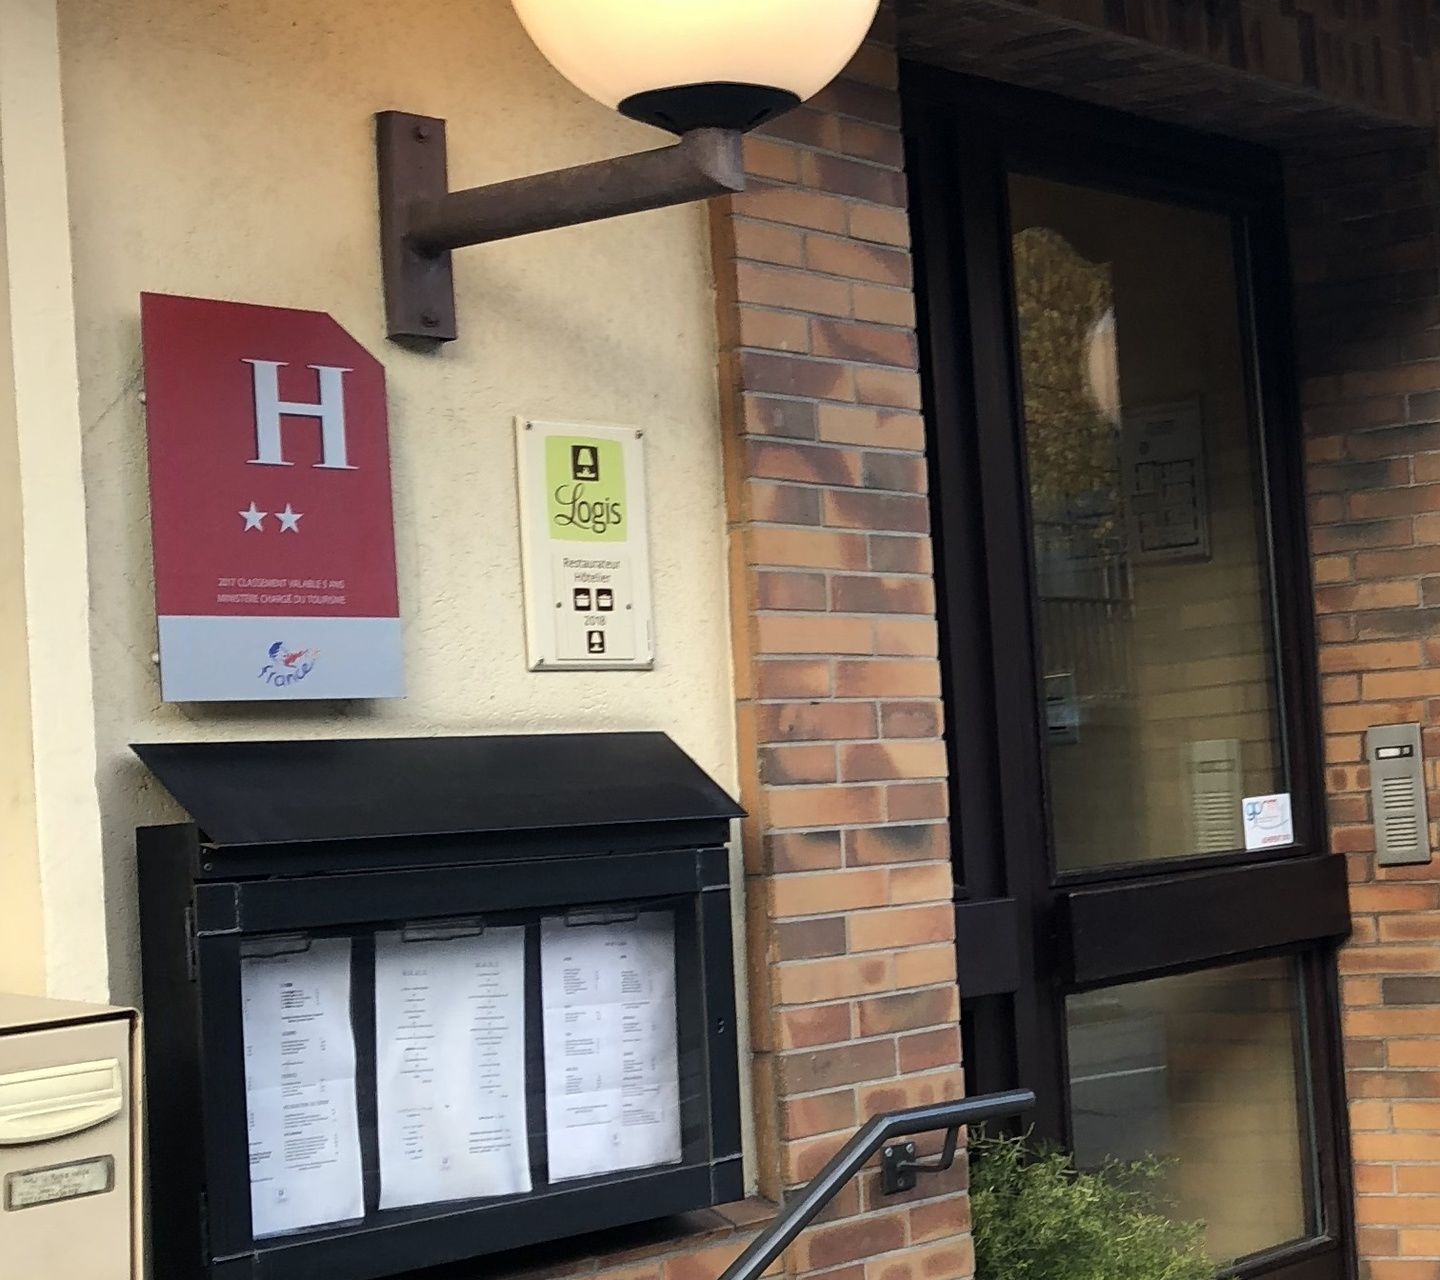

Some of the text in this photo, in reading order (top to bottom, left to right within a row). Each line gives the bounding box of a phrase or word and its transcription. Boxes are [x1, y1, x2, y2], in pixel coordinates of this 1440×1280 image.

[241, 358, 360, 470] H
[554, 483, 622, 534] Logis
[563, 558, 620, 569] Restaurateur
